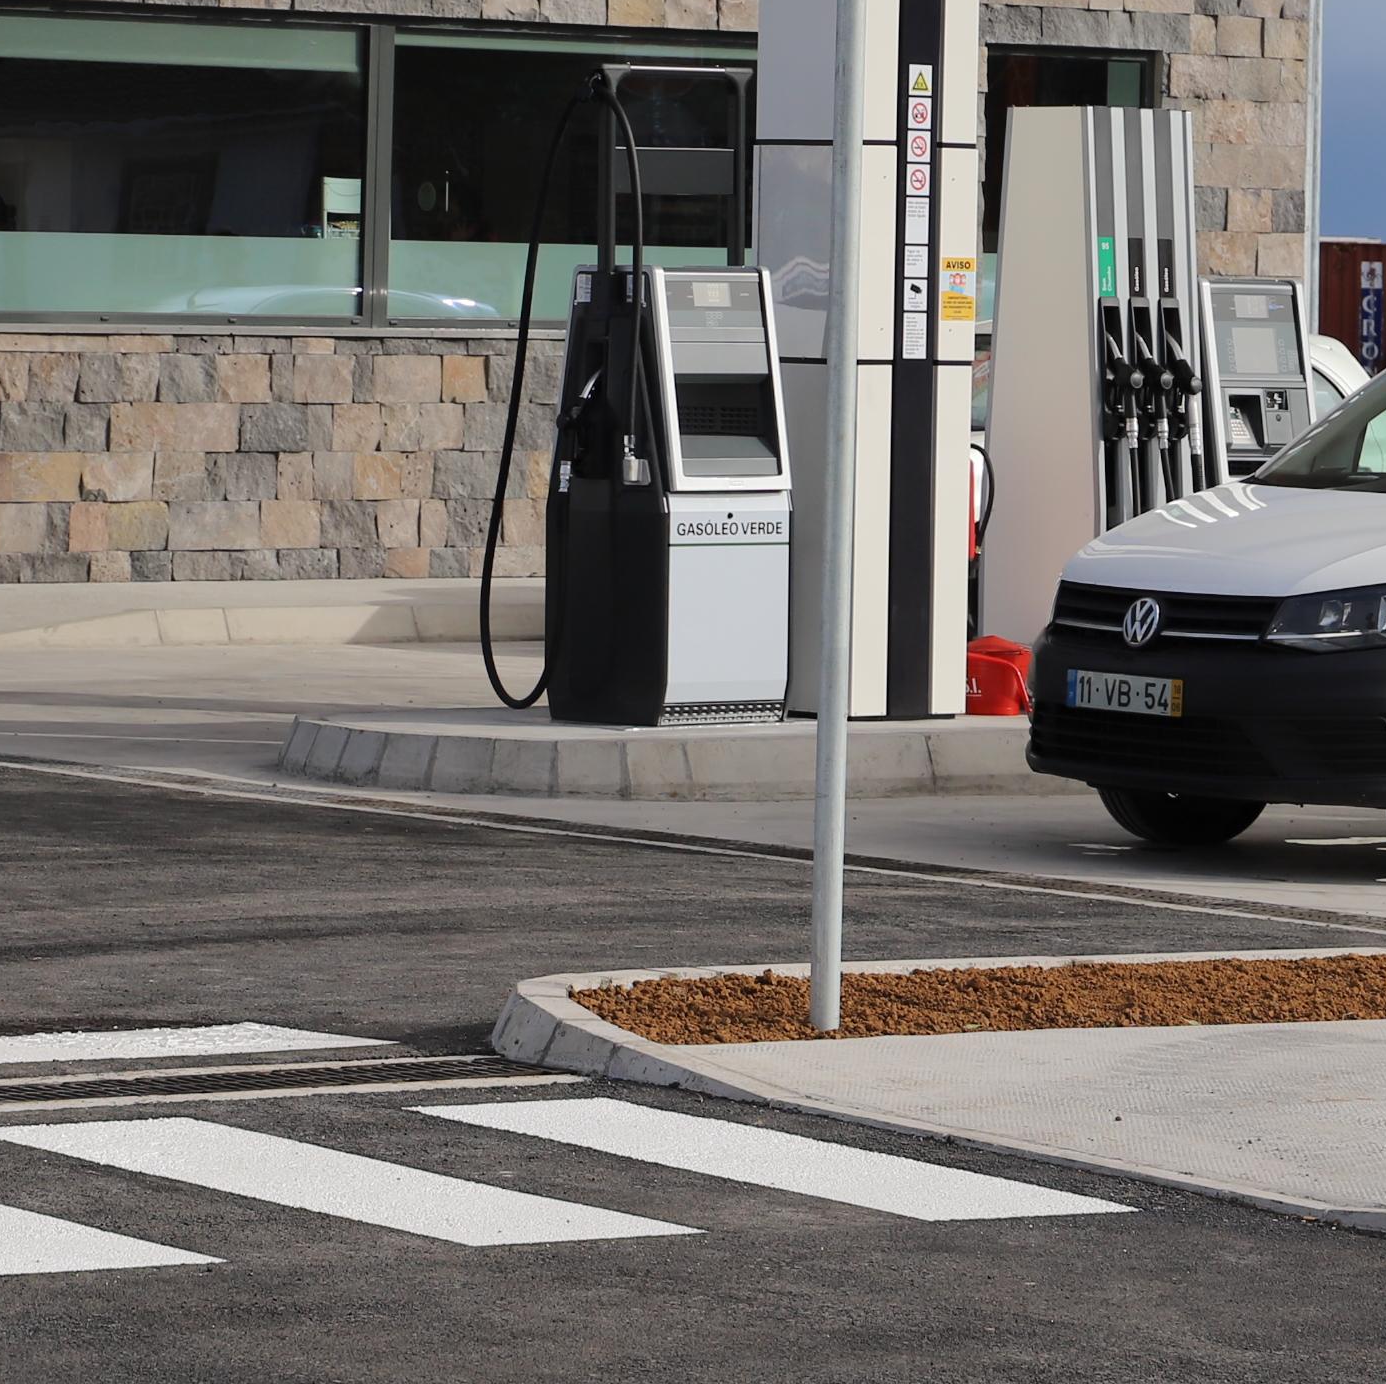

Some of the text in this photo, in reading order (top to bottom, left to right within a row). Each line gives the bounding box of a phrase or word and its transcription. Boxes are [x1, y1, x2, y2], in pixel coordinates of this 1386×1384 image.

[945, 260, 971, 270] AVISO
[676, 519, 783, 536] GASÓLEO VERDE
